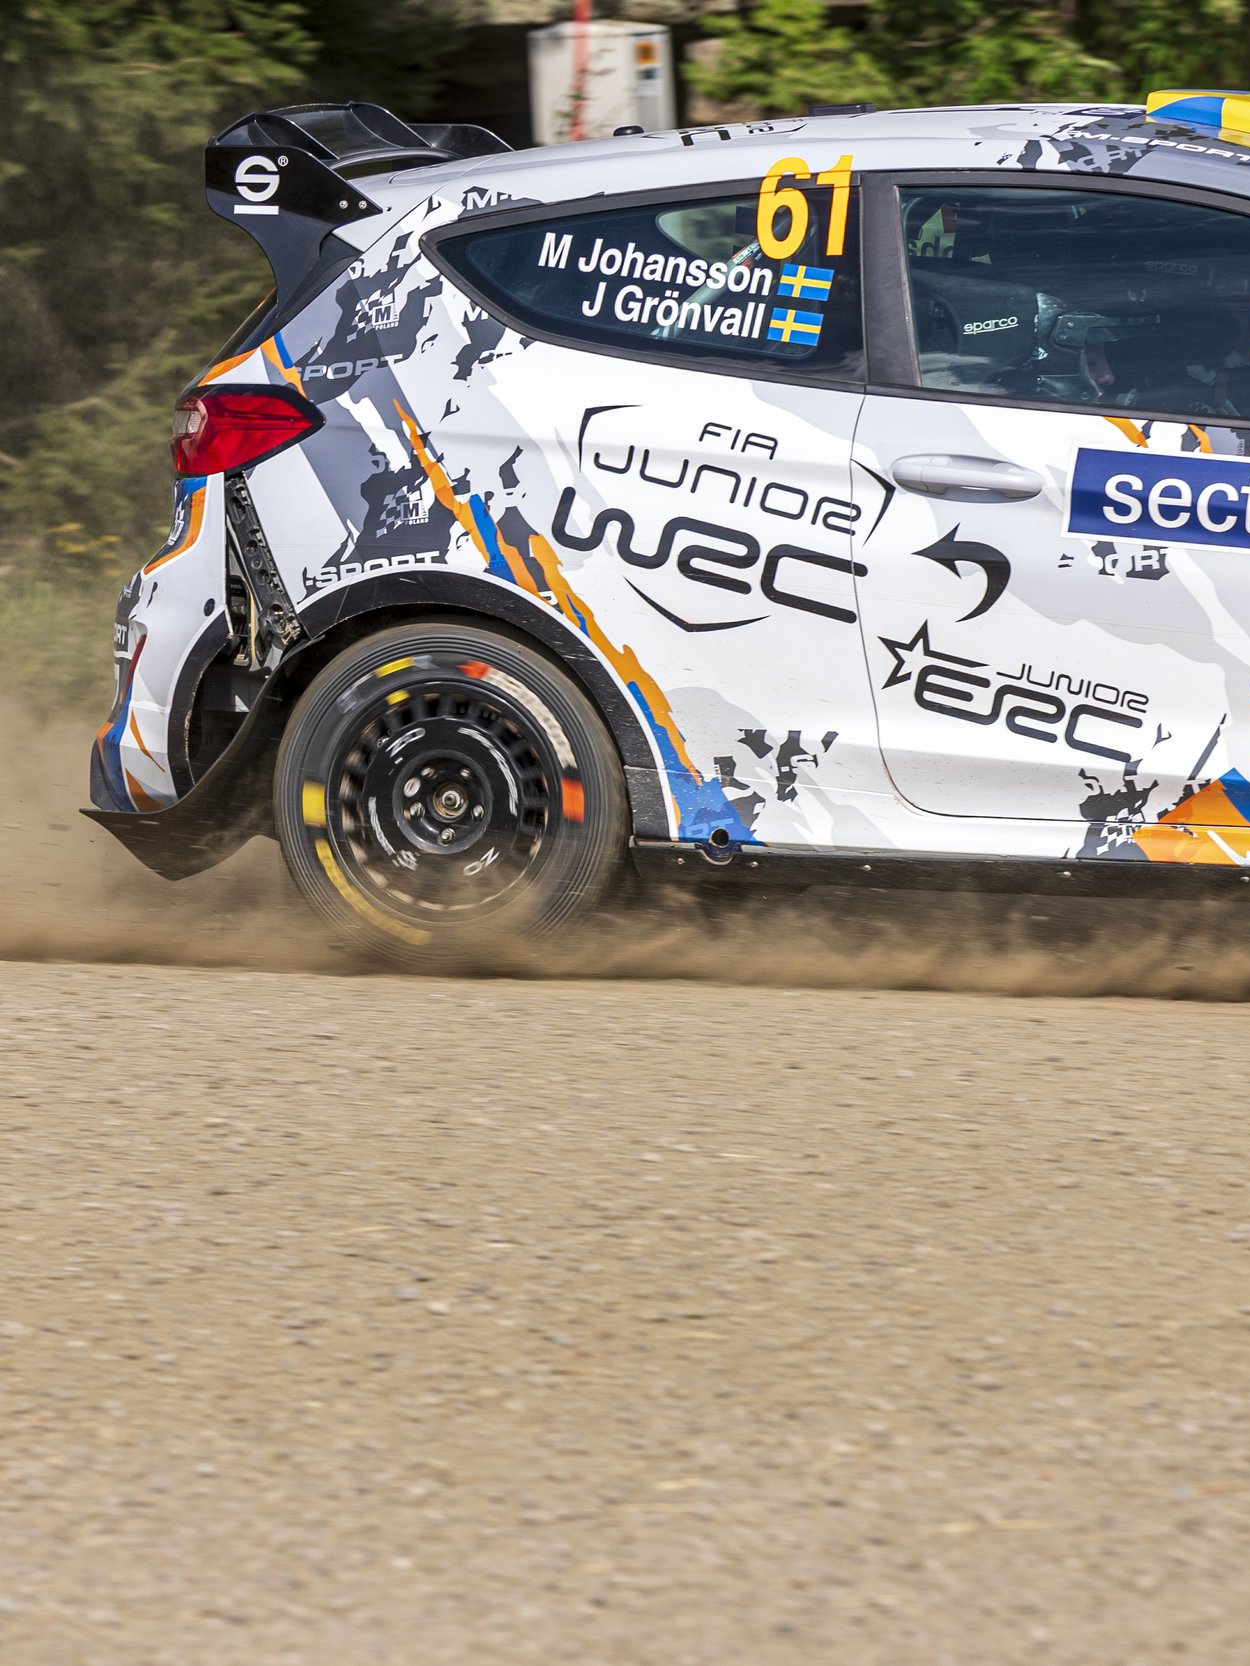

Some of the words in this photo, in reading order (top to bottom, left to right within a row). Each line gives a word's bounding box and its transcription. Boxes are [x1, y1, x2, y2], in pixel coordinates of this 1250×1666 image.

[757, 155, 853, 260] 61
[538, 233, 574, 269] M
[579, 238, 773, 296] Johansson
[582, 282, 607, 317] J
[615, 285, 766, 339] Grönvall
[963, 315, 1019, 335] sparco
[699, 422, 778, 460] FIA
[594, 445, 861, 536] JUNIOR
[552, 486, 868, 624] WRC
[915, 664, 1143, 763] ERC
[996, 663, 1149, 714] JUNIOR
